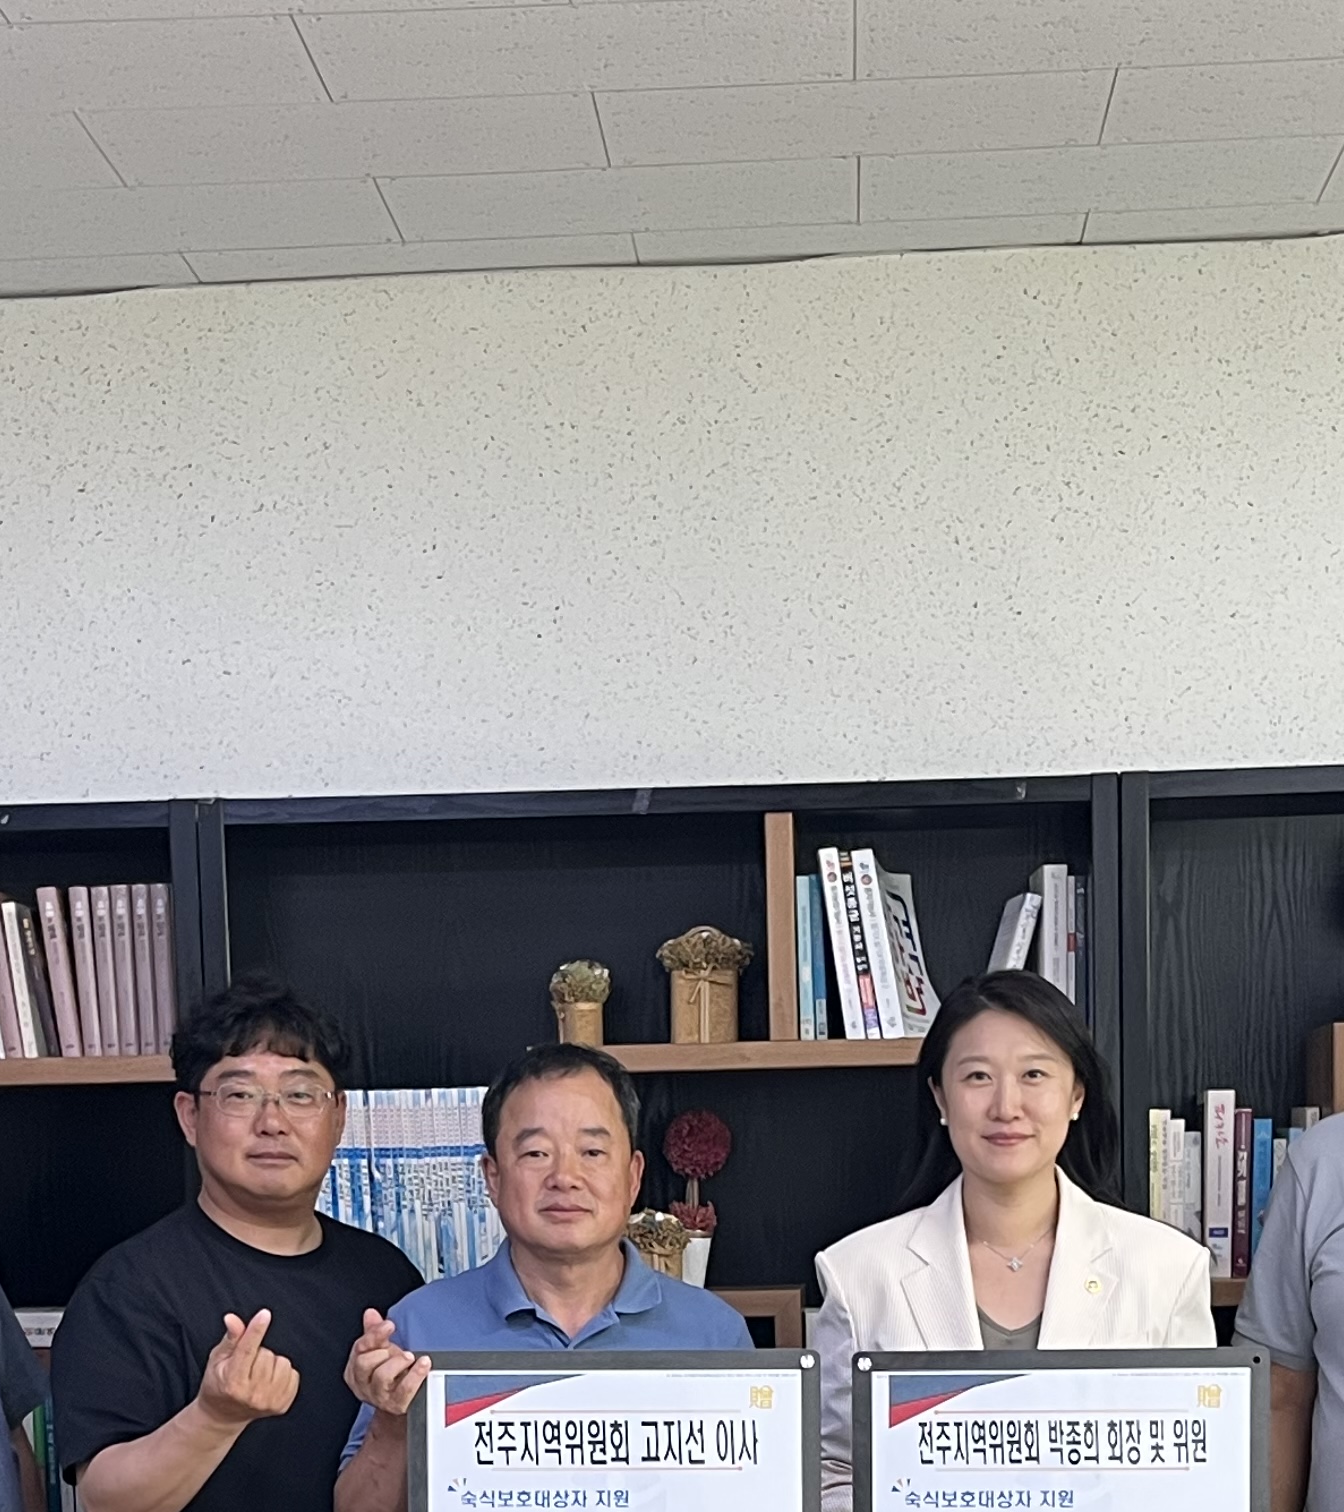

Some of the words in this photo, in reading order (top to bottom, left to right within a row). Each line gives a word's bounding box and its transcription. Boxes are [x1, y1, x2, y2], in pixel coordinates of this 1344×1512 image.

[474, 1418, 631, 1466] 전주지역위원회
[640, 1418, 706, 1466] 고지선
[715, 1418, 760, 1466] 이사
[917, 1418, 1041, 1466] 전주지역위원회
[1047, 1418, 1100, 1466] 박종희
[1107, 1418, 1142, 1465] 회장
[1149, 1419, 1166, 1464] 및
[1172, 1418, 1207, 1464] 위원
[460, 1489, 588, 1508] 숙식보호대상자
[594, 1489, 630, 1508] 지원
[905, 1489, 1032, 1509] 숙식보호대상자
[1039, 1489, 1074, 1509] 지원
